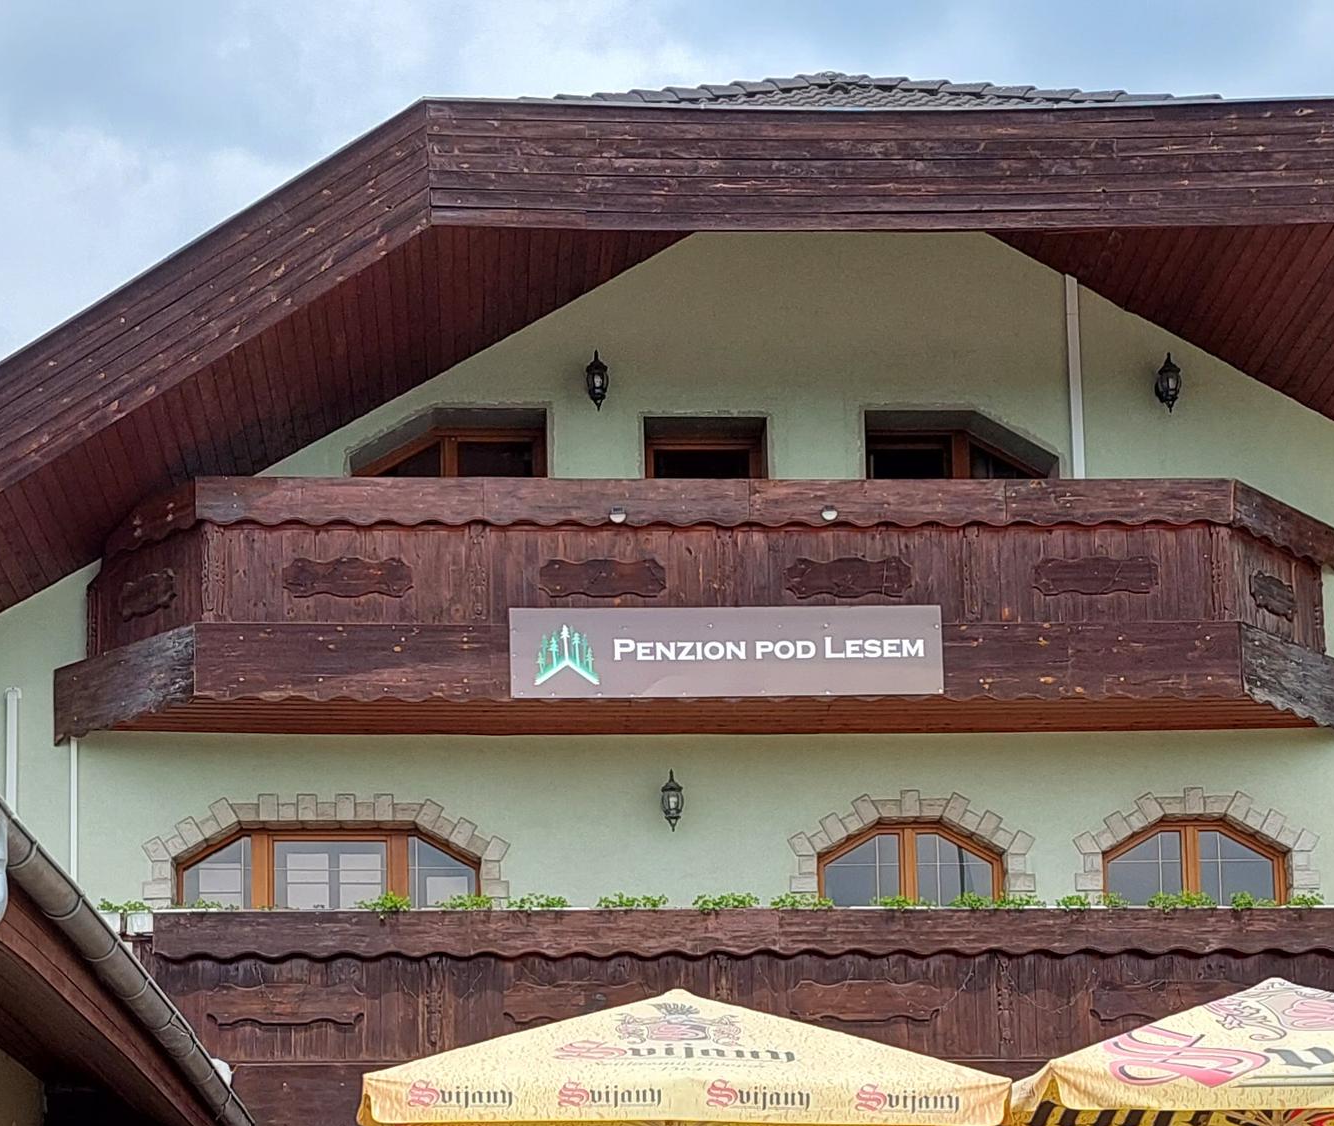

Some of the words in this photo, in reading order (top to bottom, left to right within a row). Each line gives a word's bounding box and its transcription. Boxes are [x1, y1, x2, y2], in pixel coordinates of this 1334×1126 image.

[613, 637, 746, 662] PENZION
[755, 639, 816, 660] POD
[824, 636, 925, 660] LESEM
[553, 1040, 796, 1064] Svijany
[408, 1080, 513, 1109] Svijany
[558, 1080, 662, 1108] Svijany
[706, 1078, 811, 1111] Svijany
[854, 1083, 959, 1114] Svijany
